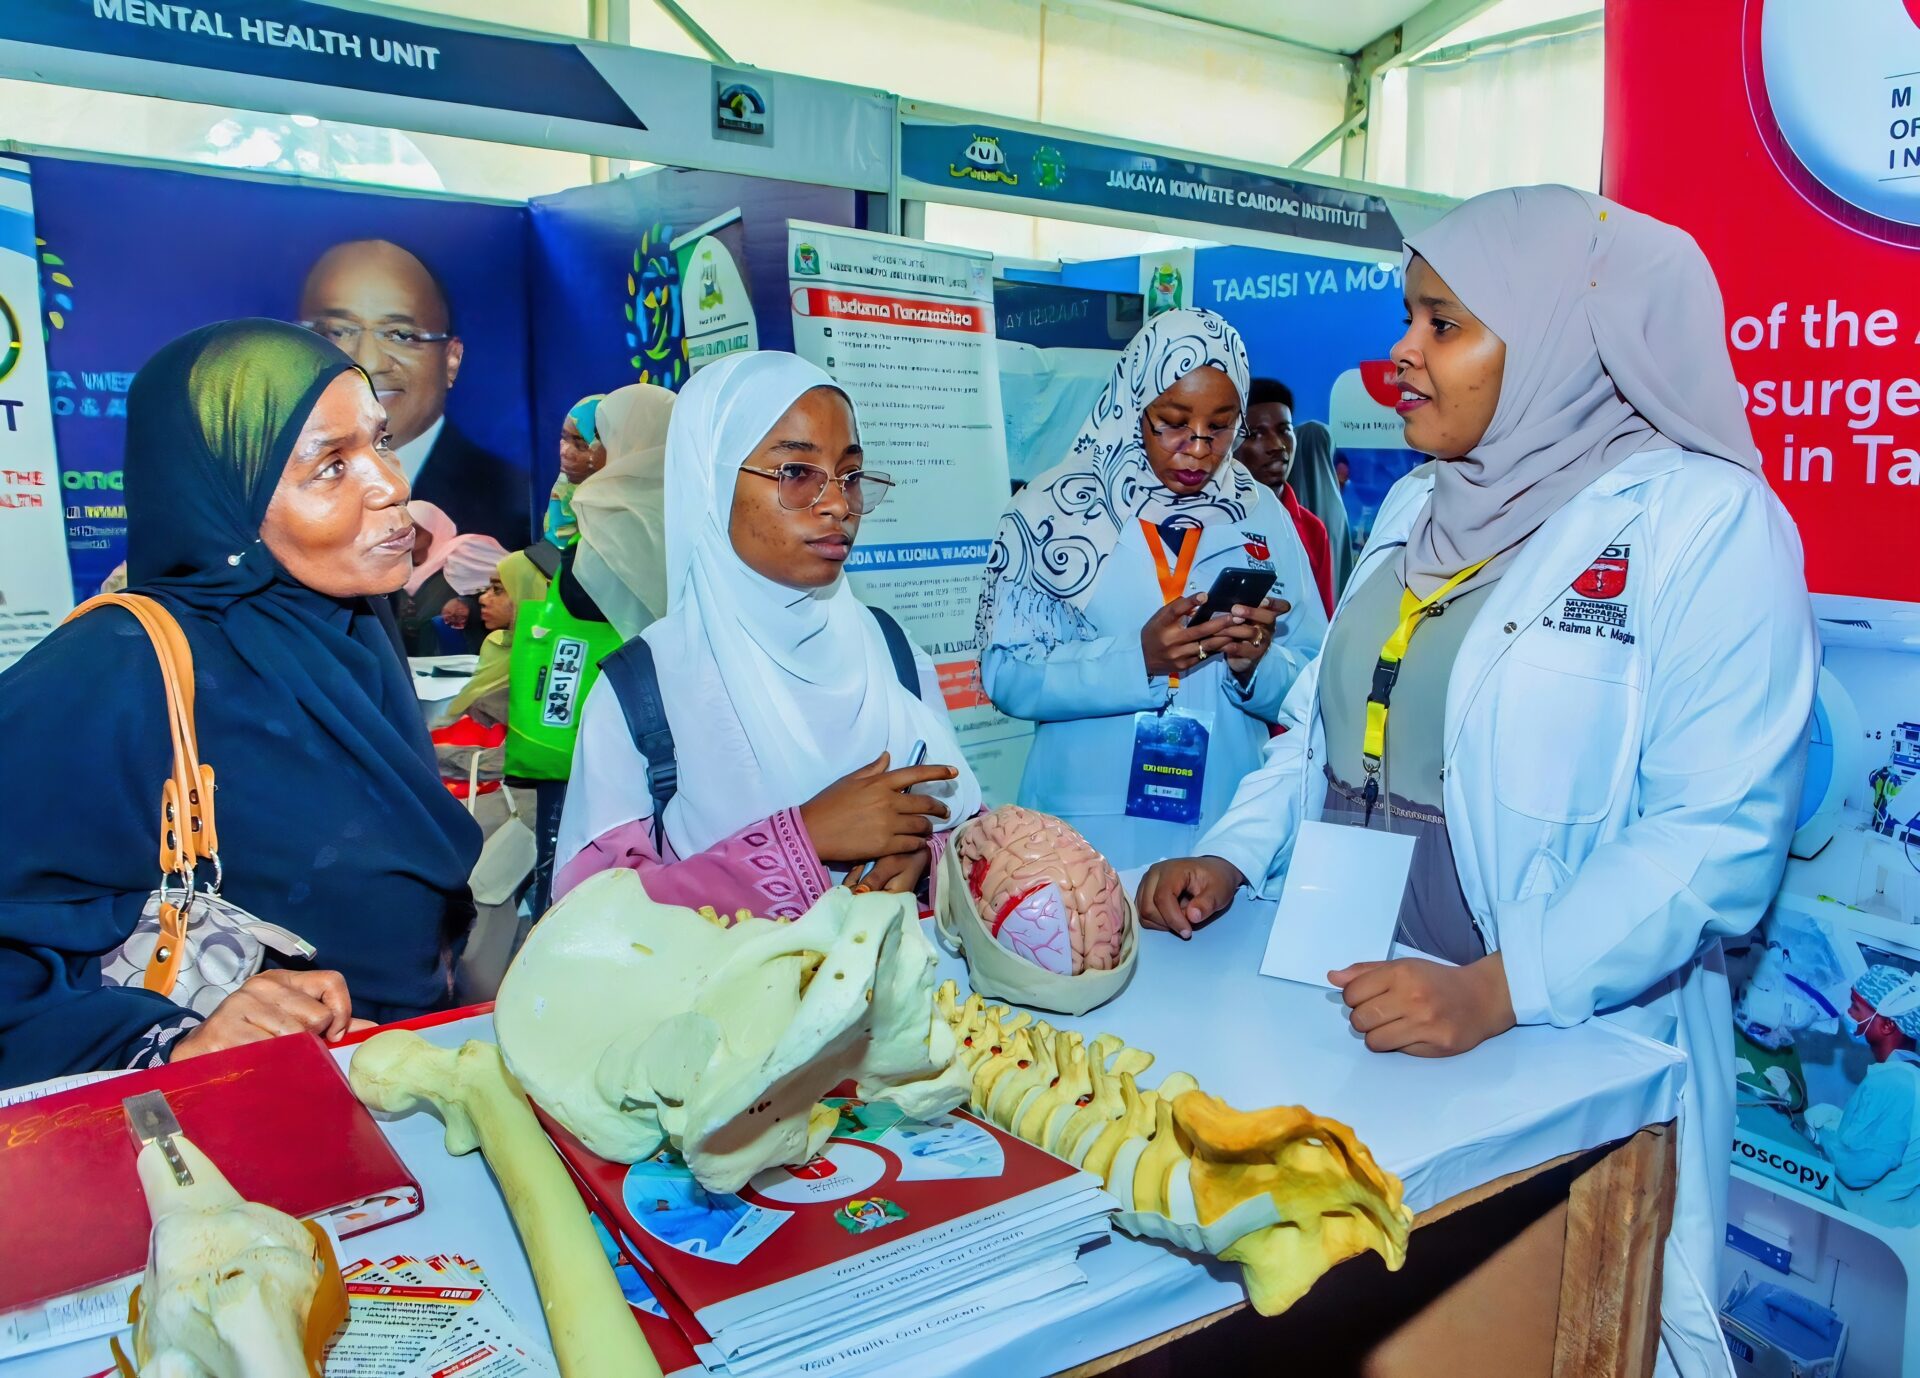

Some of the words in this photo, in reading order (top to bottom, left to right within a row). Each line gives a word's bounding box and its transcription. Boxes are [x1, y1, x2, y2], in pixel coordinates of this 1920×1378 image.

[93, 0, 234, 38] MENTAL
[239, 17, 362, 58] HEALTH
[369, 37, 441, 70] UNIT
[1106, 170, 1166, 196] JAKAYA
[1169, 179, 1234, 206] KIKWETE
[1237, 191, 1299, 217] CARDIAC
[1212, 272, 1298, 303] TAASISI
[1304, 270, 1338, 296] YA
[1730, 301, 1788, 351] of
[1801, 299, 1899, 349] the
[1782, 433, 1833, 483] in
[1563, 612, 1626, 627] INSTITUTE
[1564, 606, 1628, 620] ORTHOPAEDIC
[1566, 601, 1627, 613] MUHIMBILI
[1543, 616, 1555, 629] Dr.
[1559, 621, 1591, 635] Rahma
[1596, 624, 1606, 638] K.
[1142, 763, 1194, 777] EXHIBITORS
[1731, 1138, 1830, 1190] roscopy
